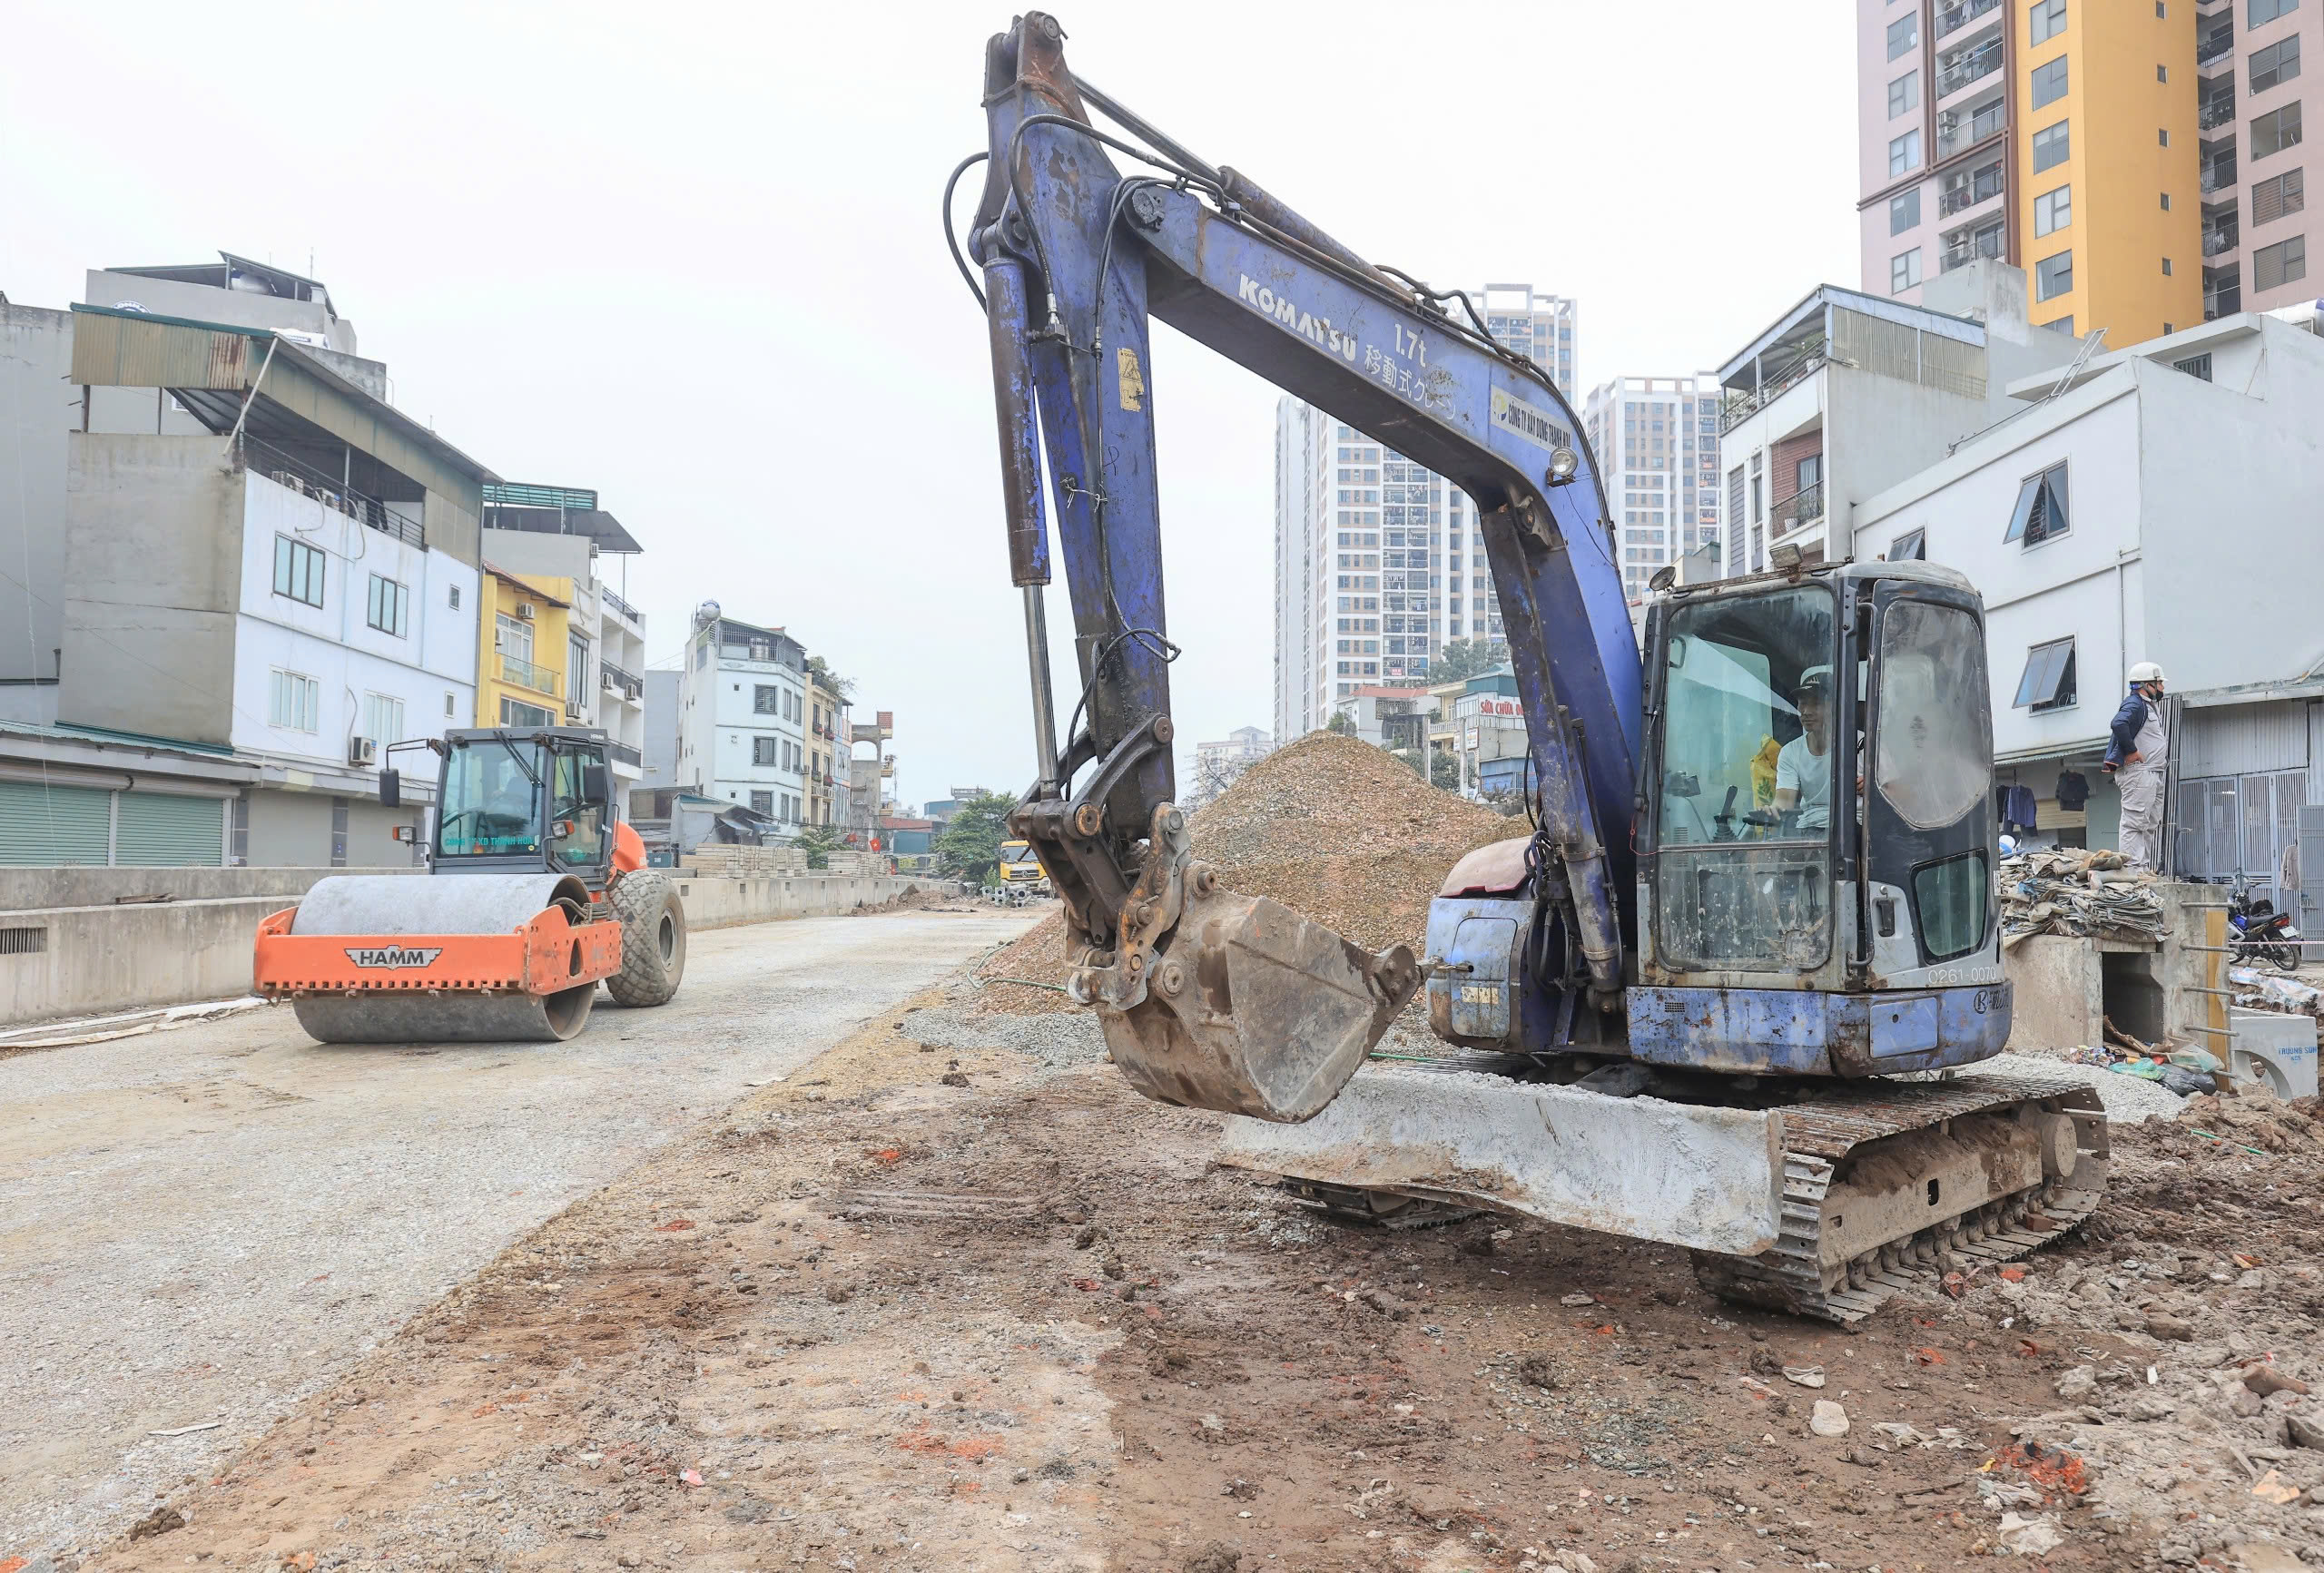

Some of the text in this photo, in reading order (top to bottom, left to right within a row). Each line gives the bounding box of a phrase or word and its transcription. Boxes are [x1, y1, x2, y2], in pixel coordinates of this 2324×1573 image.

[1238, 273, 1356, 361] KOMATSU
[1394, 323, 1427, 368] 1.7t
[359, 950, 424, 965] HAMM
[1928, 966, 1996, 985] 0261-0070
